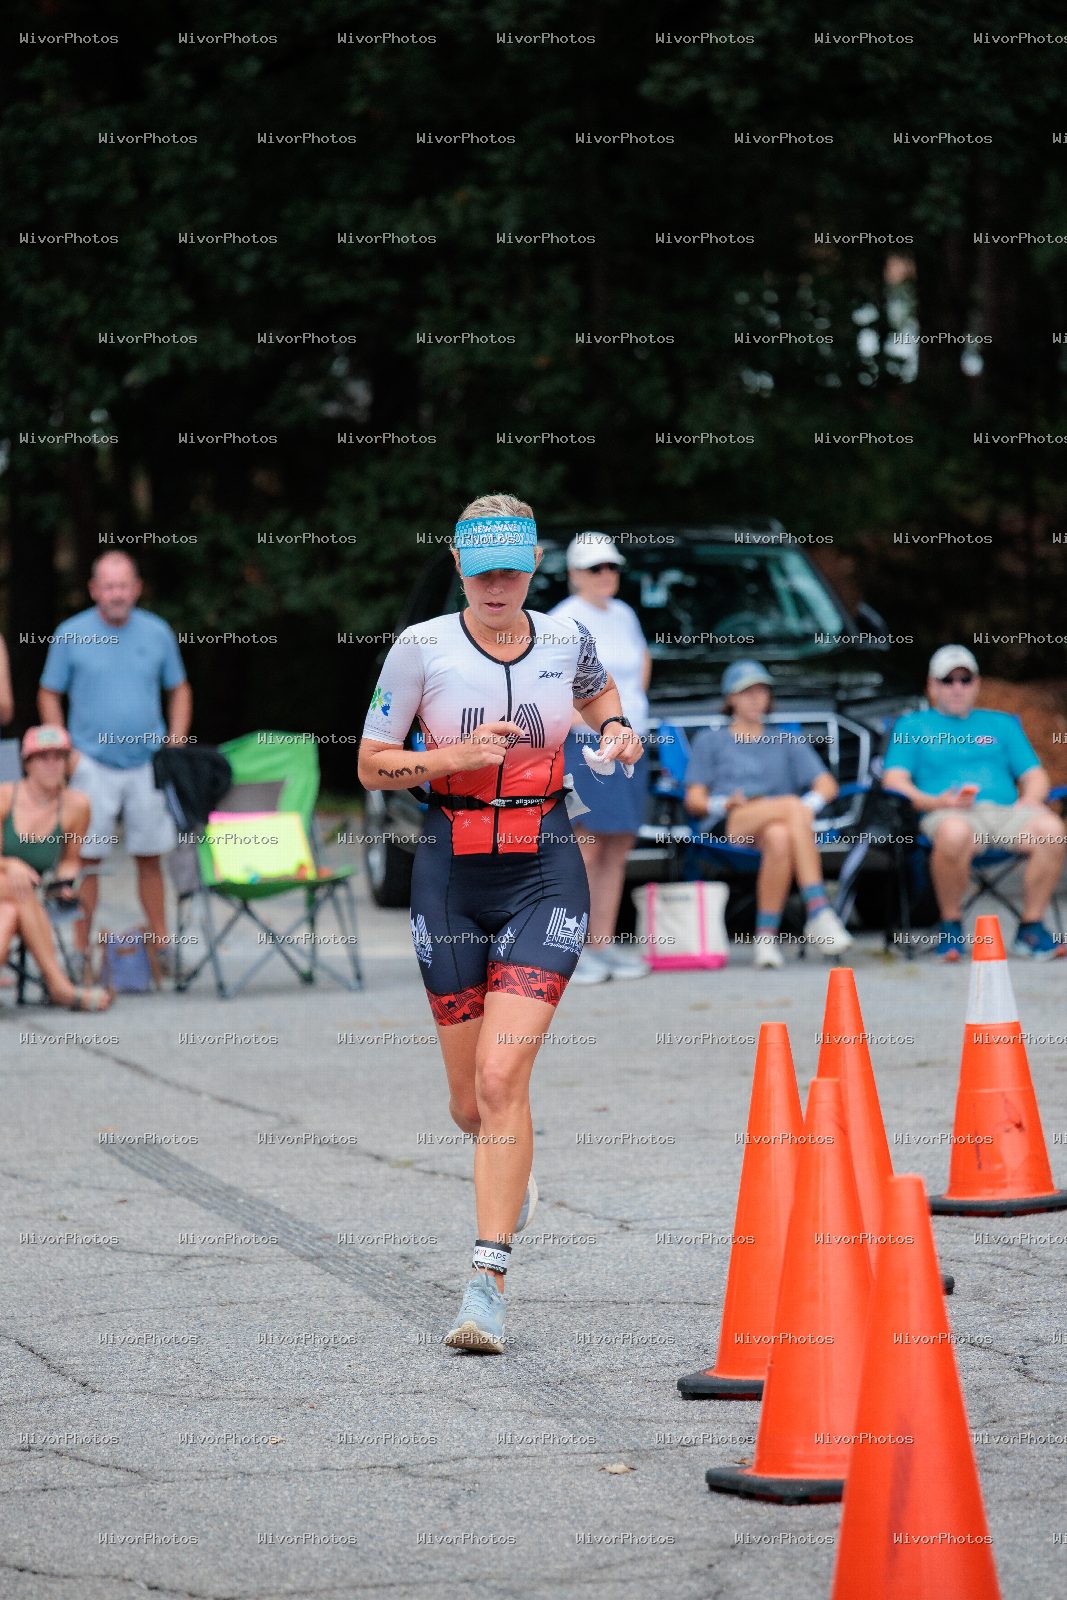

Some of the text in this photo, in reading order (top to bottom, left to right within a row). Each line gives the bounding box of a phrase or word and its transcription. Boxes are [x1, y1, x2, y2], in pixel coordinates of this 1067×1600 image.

[473, 523, 518, 533] NEW WAVE
[474, 1248, 507, 1262] MYLAPS
